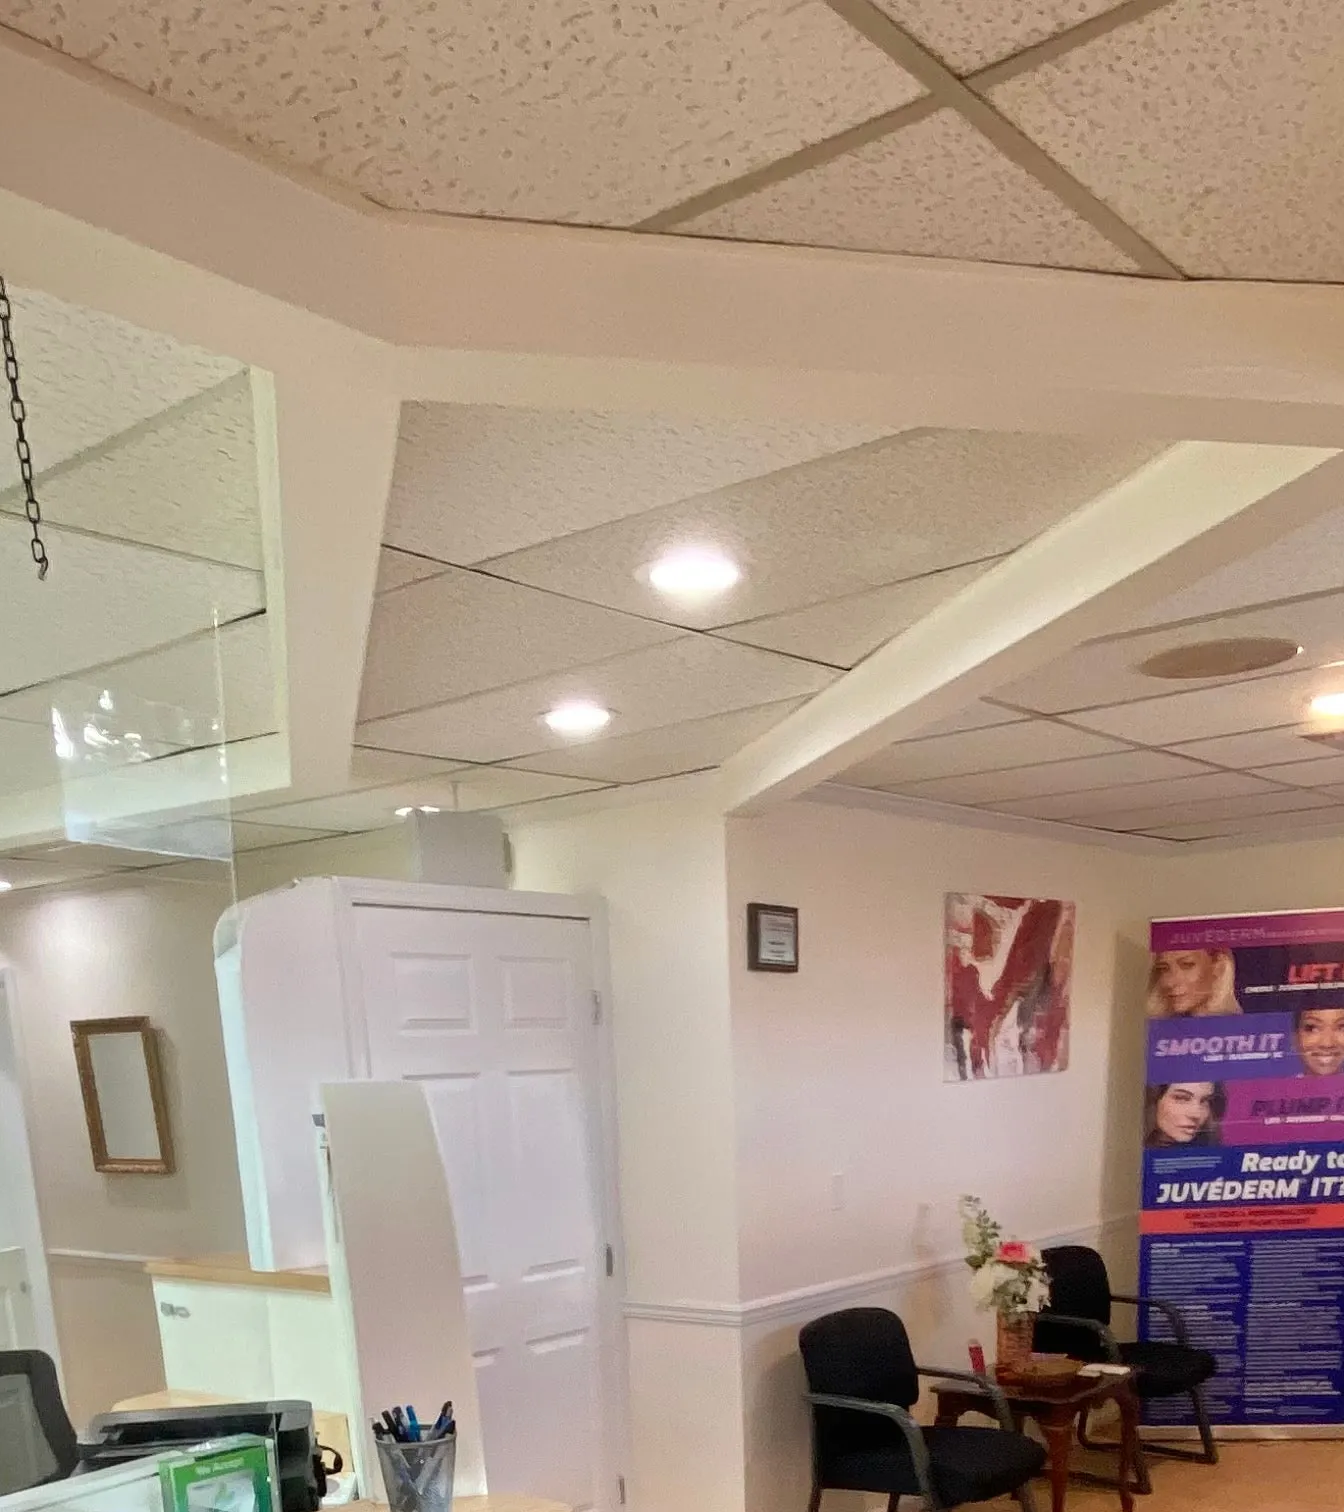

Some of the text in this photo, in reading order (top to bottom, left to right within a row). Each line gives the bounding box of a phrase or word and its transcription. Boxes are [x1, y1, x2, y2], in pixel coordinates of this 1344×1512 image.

[1287, 963, 1340, 984] LIFT
[1155, 1034, 1256, 1057] SMOOTH
[1258, 1033, 1285, 1053] IT
[1241, 1151, 1322, 1174] Ready
